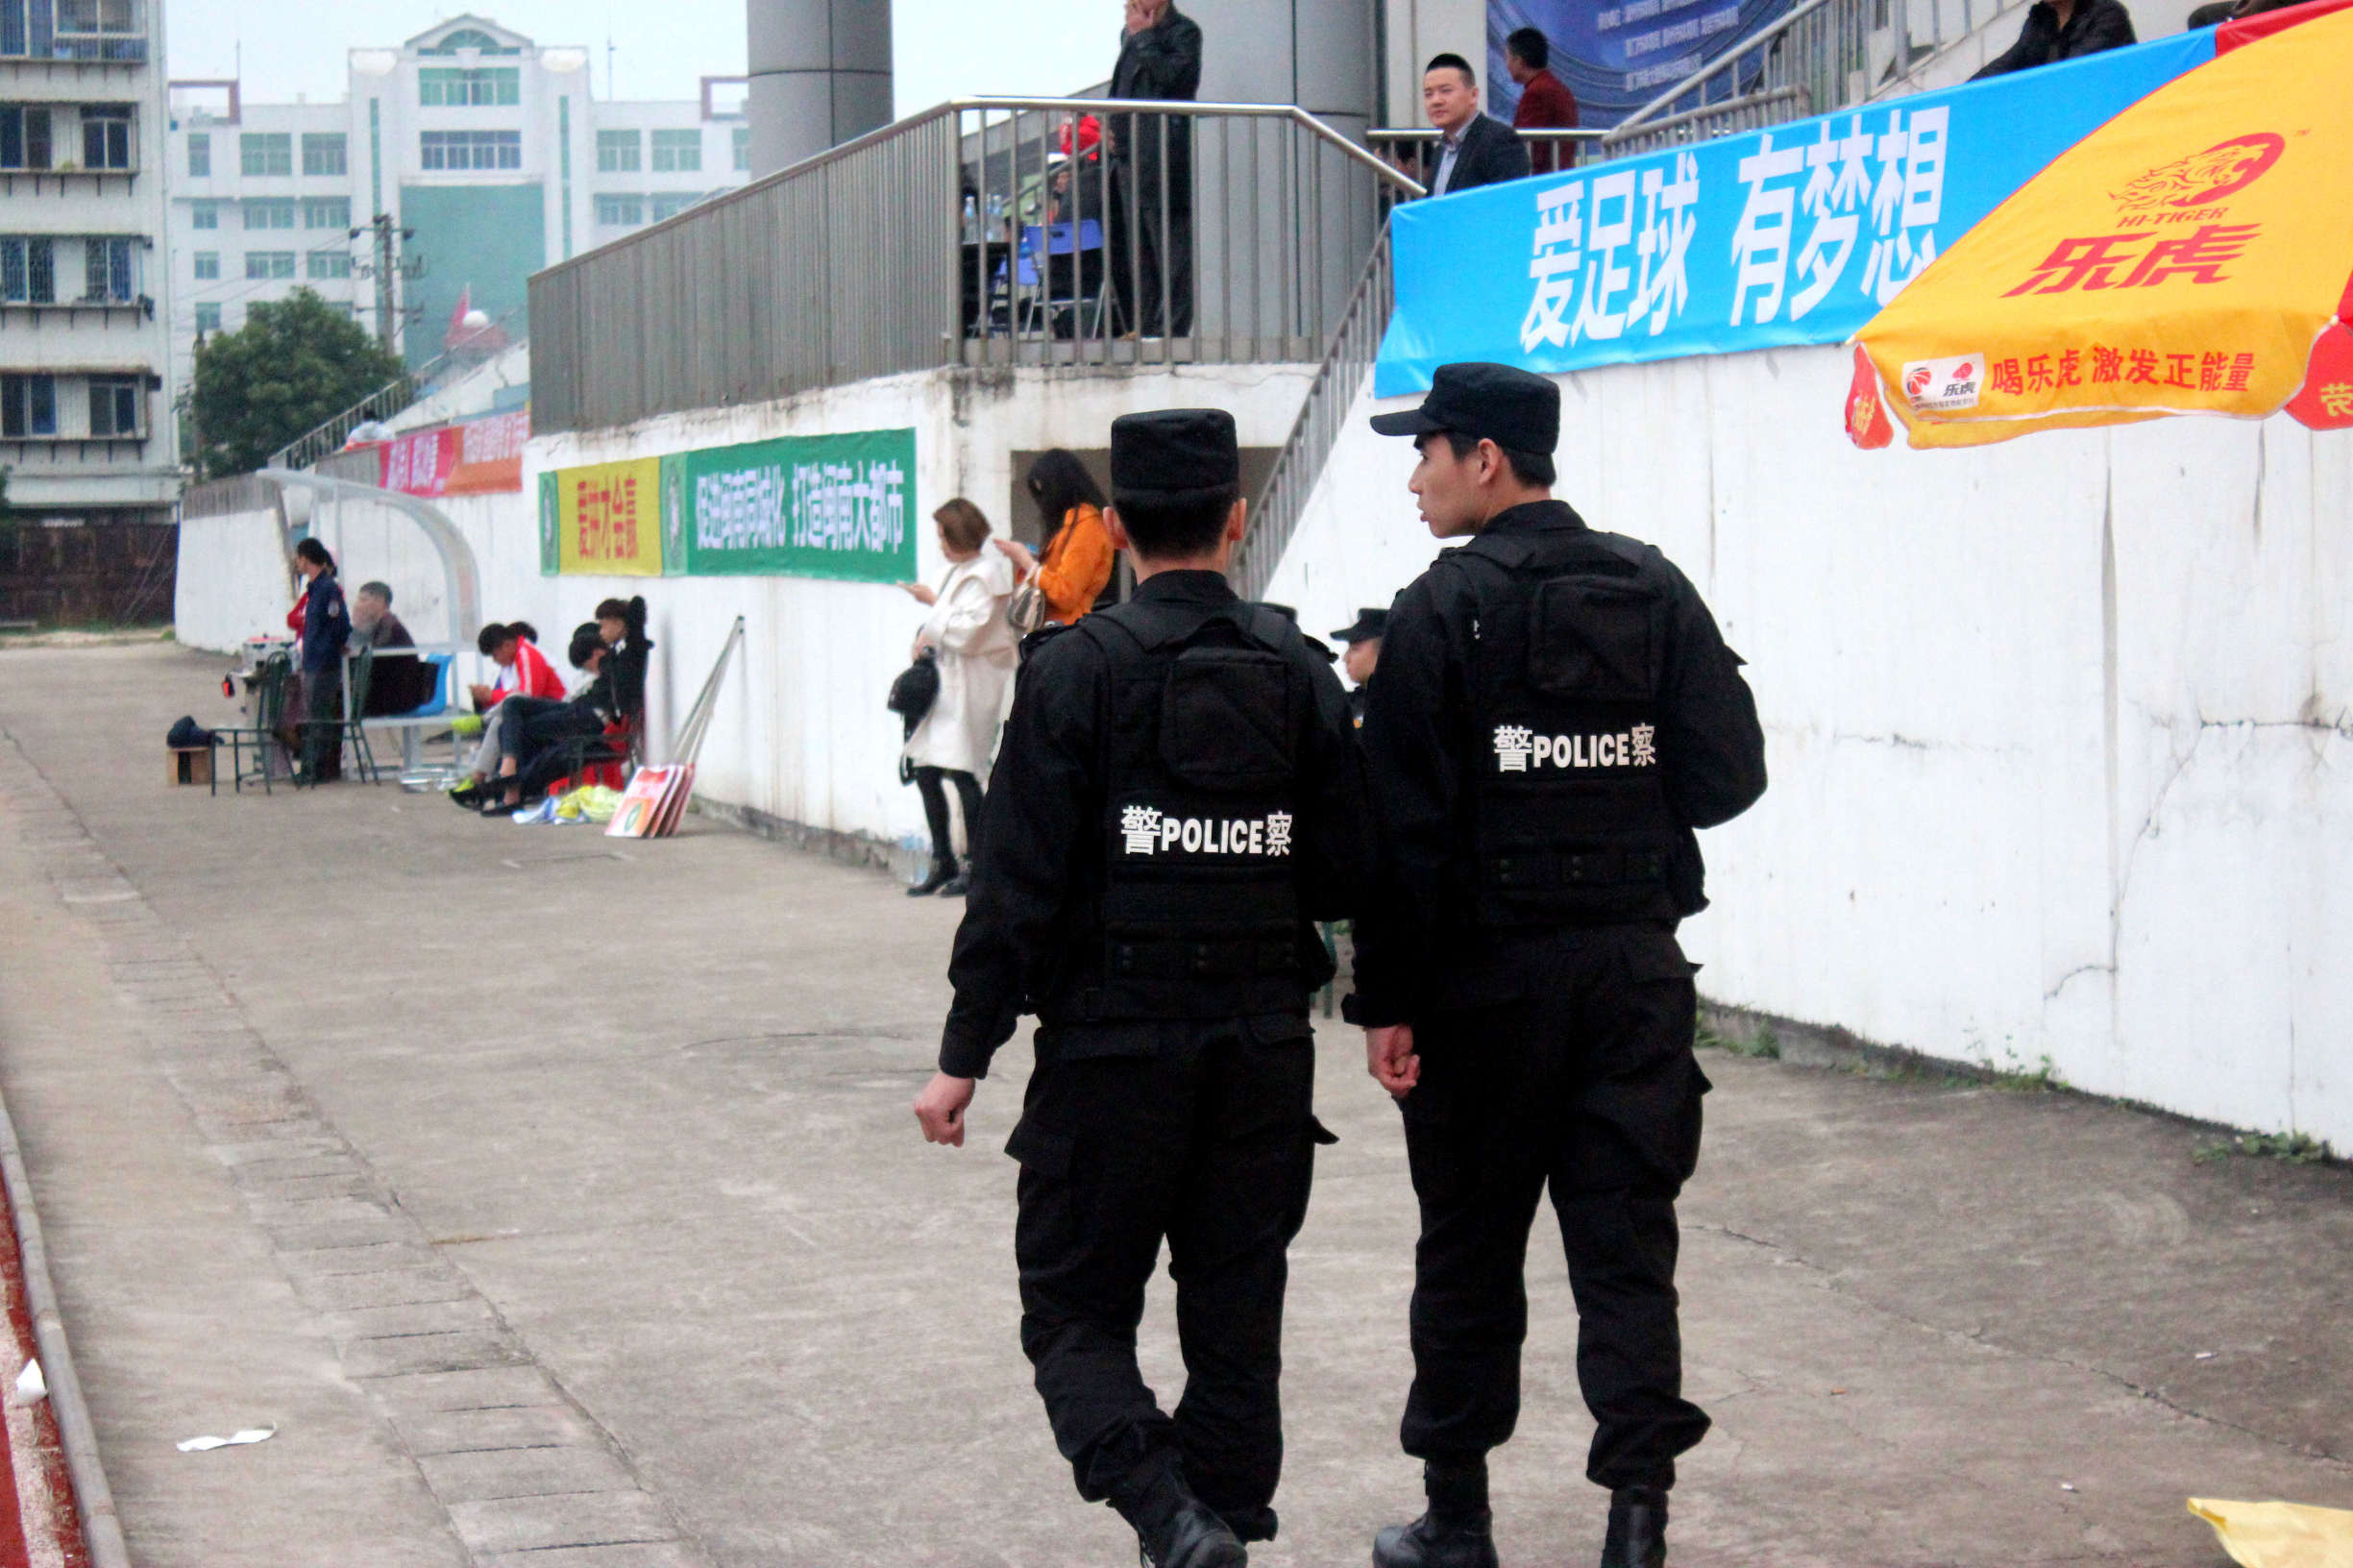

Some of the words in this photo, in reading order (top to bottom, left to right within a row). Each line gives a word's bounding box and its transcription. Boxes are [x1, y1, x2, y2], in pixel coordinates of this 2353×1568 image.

[1520, 152, 1699, 353] 爱足球
[1730, 105, 1949, 328] 有梦想
[2117, 207, 2229, 229] HI-TIGER
[2000, 222, 2262, 298] 乐虎
[1991, 349, 2083, 396] 喝乐虎
[2091, 346, 2256, 393] 激发正能量
